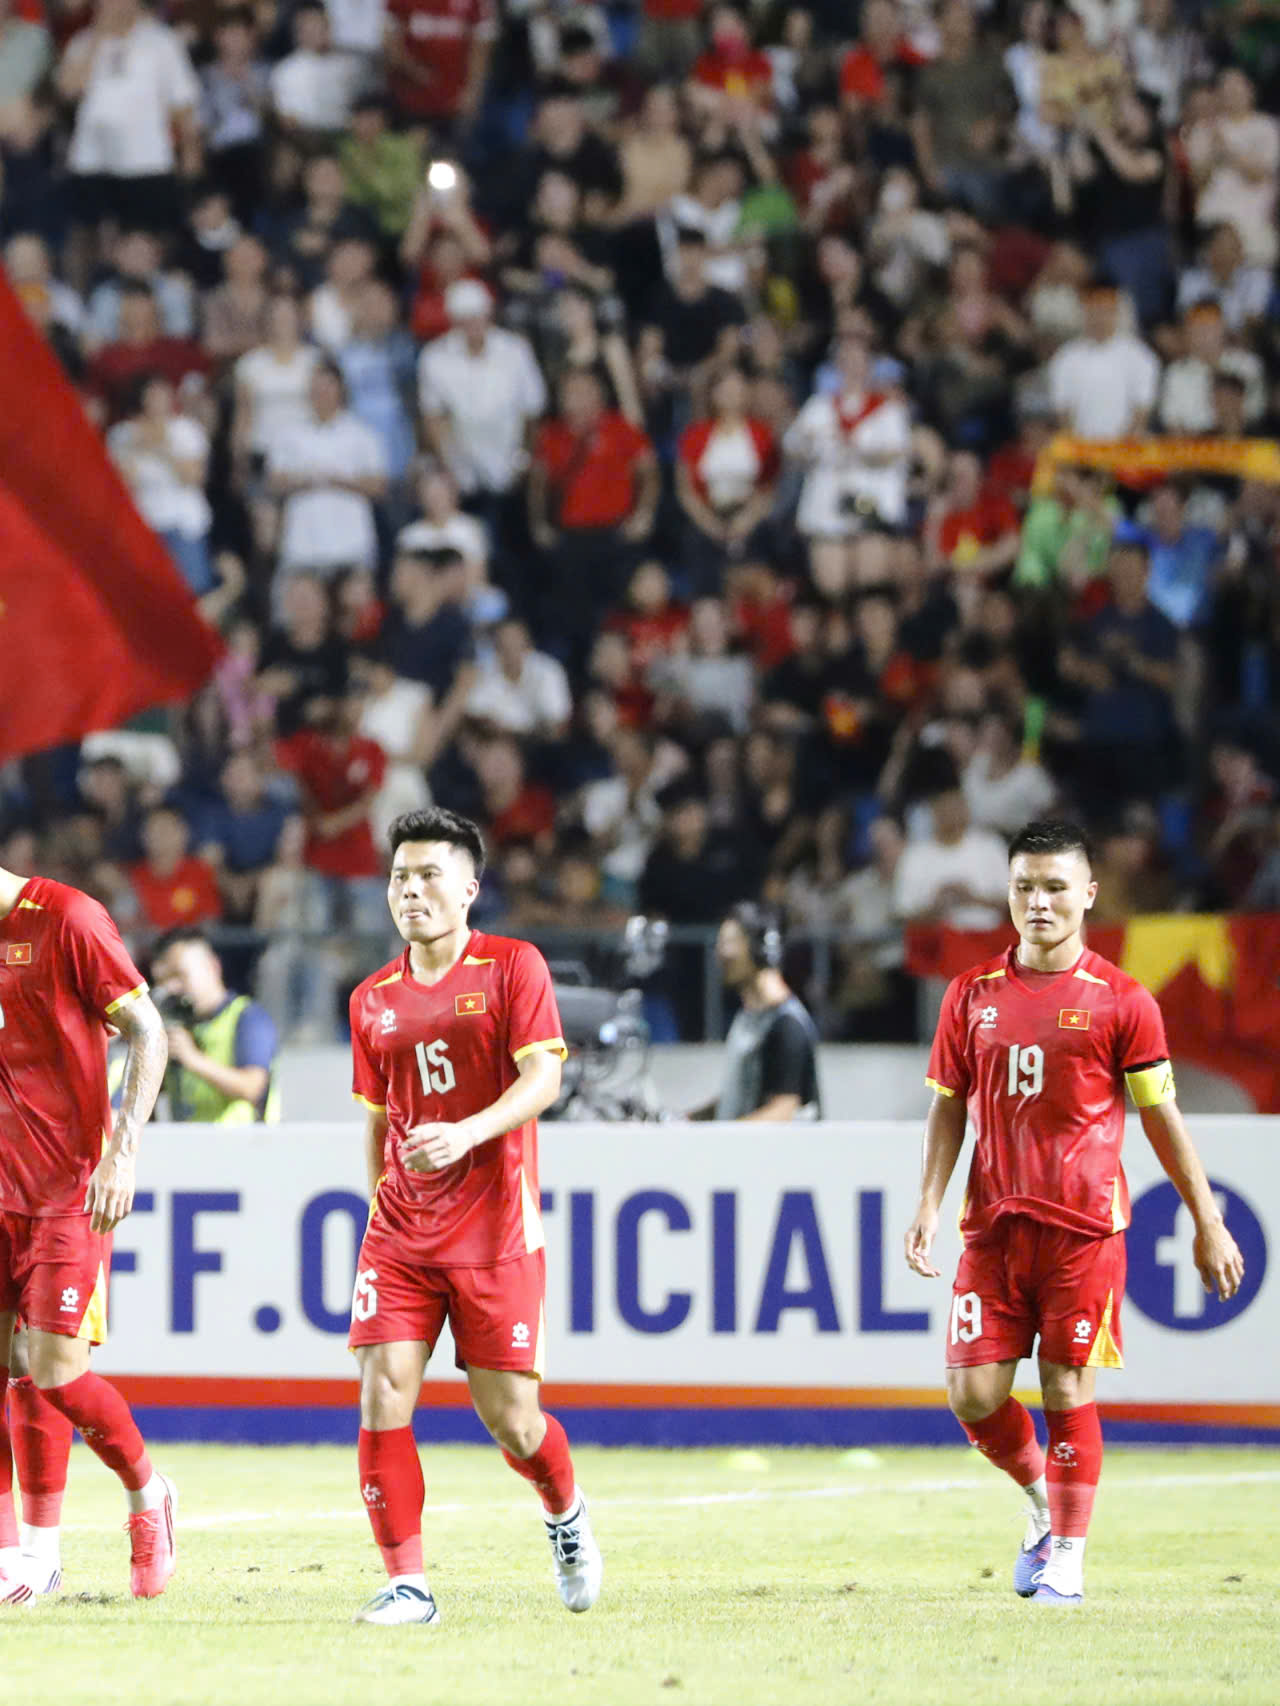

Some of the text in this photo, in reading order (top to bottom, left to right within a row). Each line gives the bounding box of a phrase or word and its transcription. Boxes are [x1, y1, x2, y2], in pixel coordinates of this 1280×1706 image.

[415, 1038, 456, 1096] 15
[1008, 1044, 1044, 1097] 19
[951, 1291, 983, 1346] 19
